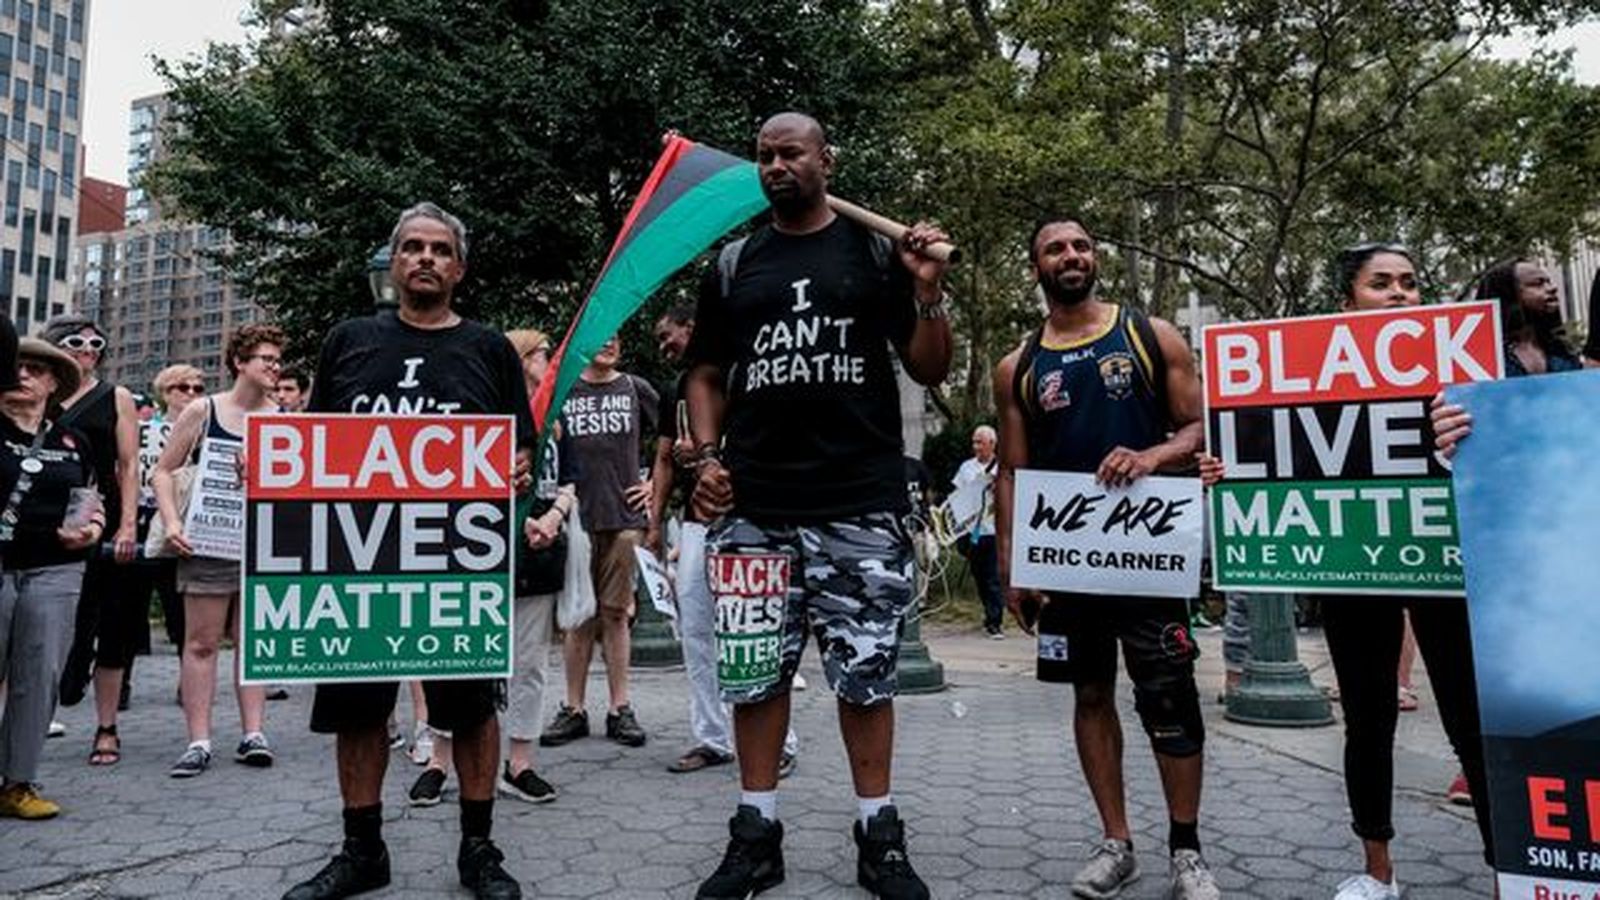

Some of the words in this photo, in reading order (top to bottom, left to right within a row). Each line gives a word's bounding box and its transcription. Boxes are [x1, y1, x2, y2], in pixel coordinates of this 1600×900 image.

[791, 278, 812, 312] I
[753, 316, 854, 355] CAN'T
[1215, 312, 1493, 397] BLACK
[398, 358, 424, 388] I
[746, 353, 865, 392] BREATHE
[1062, 346, 1096, 364] BLK
[601, 394, 631, 411] AND
[259, 425, 507, 490] BLACK
[1219, 401, 1453, 480] LIVE
[1029, 492, 1107, 532] WE
[1102, 495, 1192, 537] ARE
[1222, 486, 1453, 538] MATTE
[256, 502, 507, 572] LIVES
[1226, 544, 1325, 565] NEW
[1362, 544, 1464, 566] YOR
[1027, 546, 1081, 566] ERIC
[1086, 550, 1186, 572] GARNER
[253, 581, 508, 631] MATTER
[716, 596, 783, 633] IVES
[254, 636, 351, 657] NEW
[385, 634, 503, 655] YORK
[1527, 846, 1574, 871] SON,
